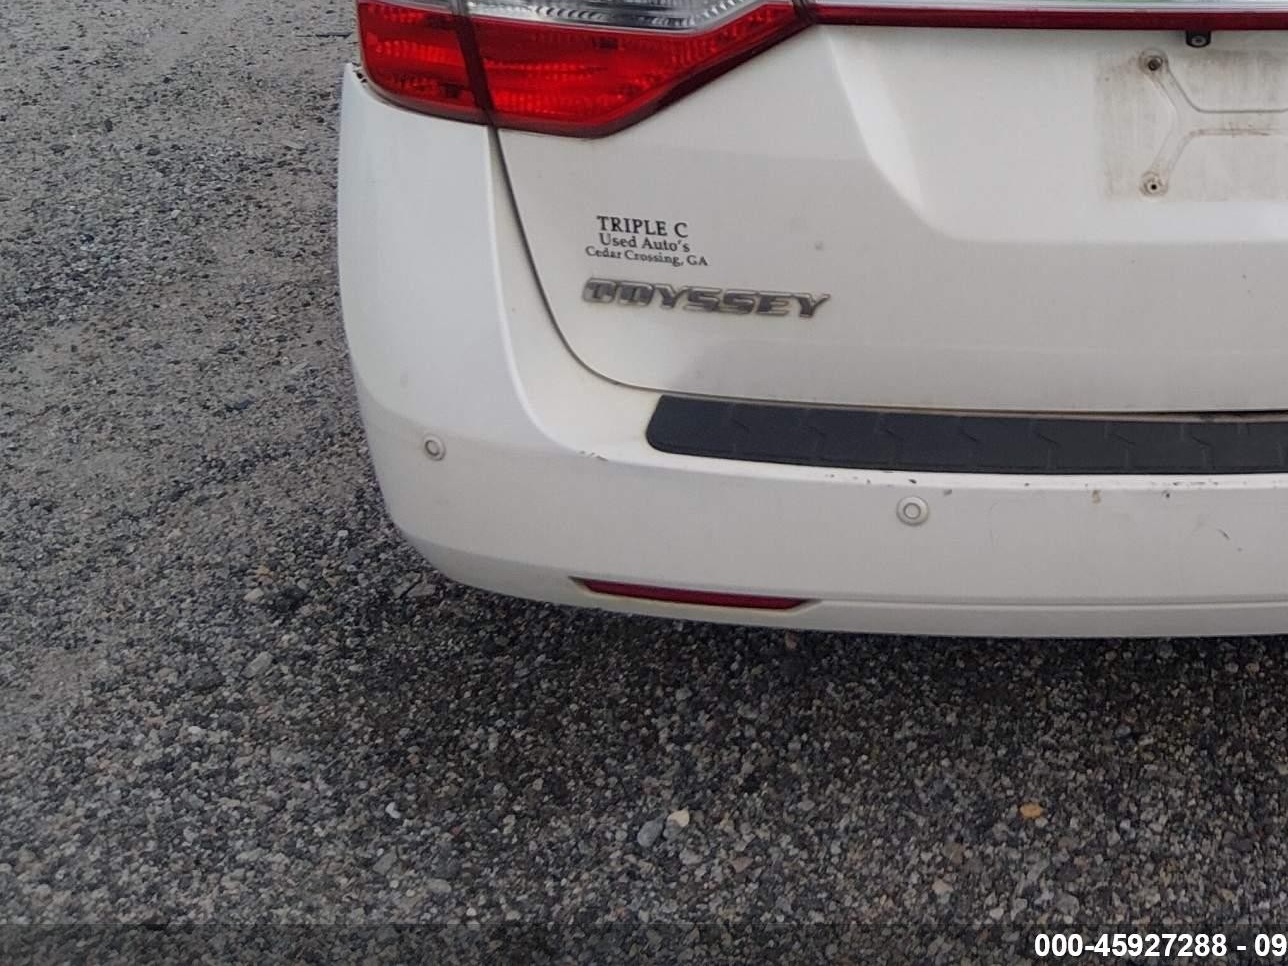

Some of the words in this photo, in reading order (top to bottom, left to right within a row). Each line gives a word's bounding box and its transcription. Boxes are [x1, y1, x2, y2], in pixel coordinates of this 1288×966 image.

[596, 215, 667, 236] TRIPLE
[674, 222, 689, 238] C
[599, 233, 637, 248] Used
[642, 238, 690, 253] Auto's
[585, 246, 622, 259] Cedar
[624, 250, 684, 267] Crossing,
[687, 255, 708, 267] GA
[582, 277, 831, 319] ODYSSEY
